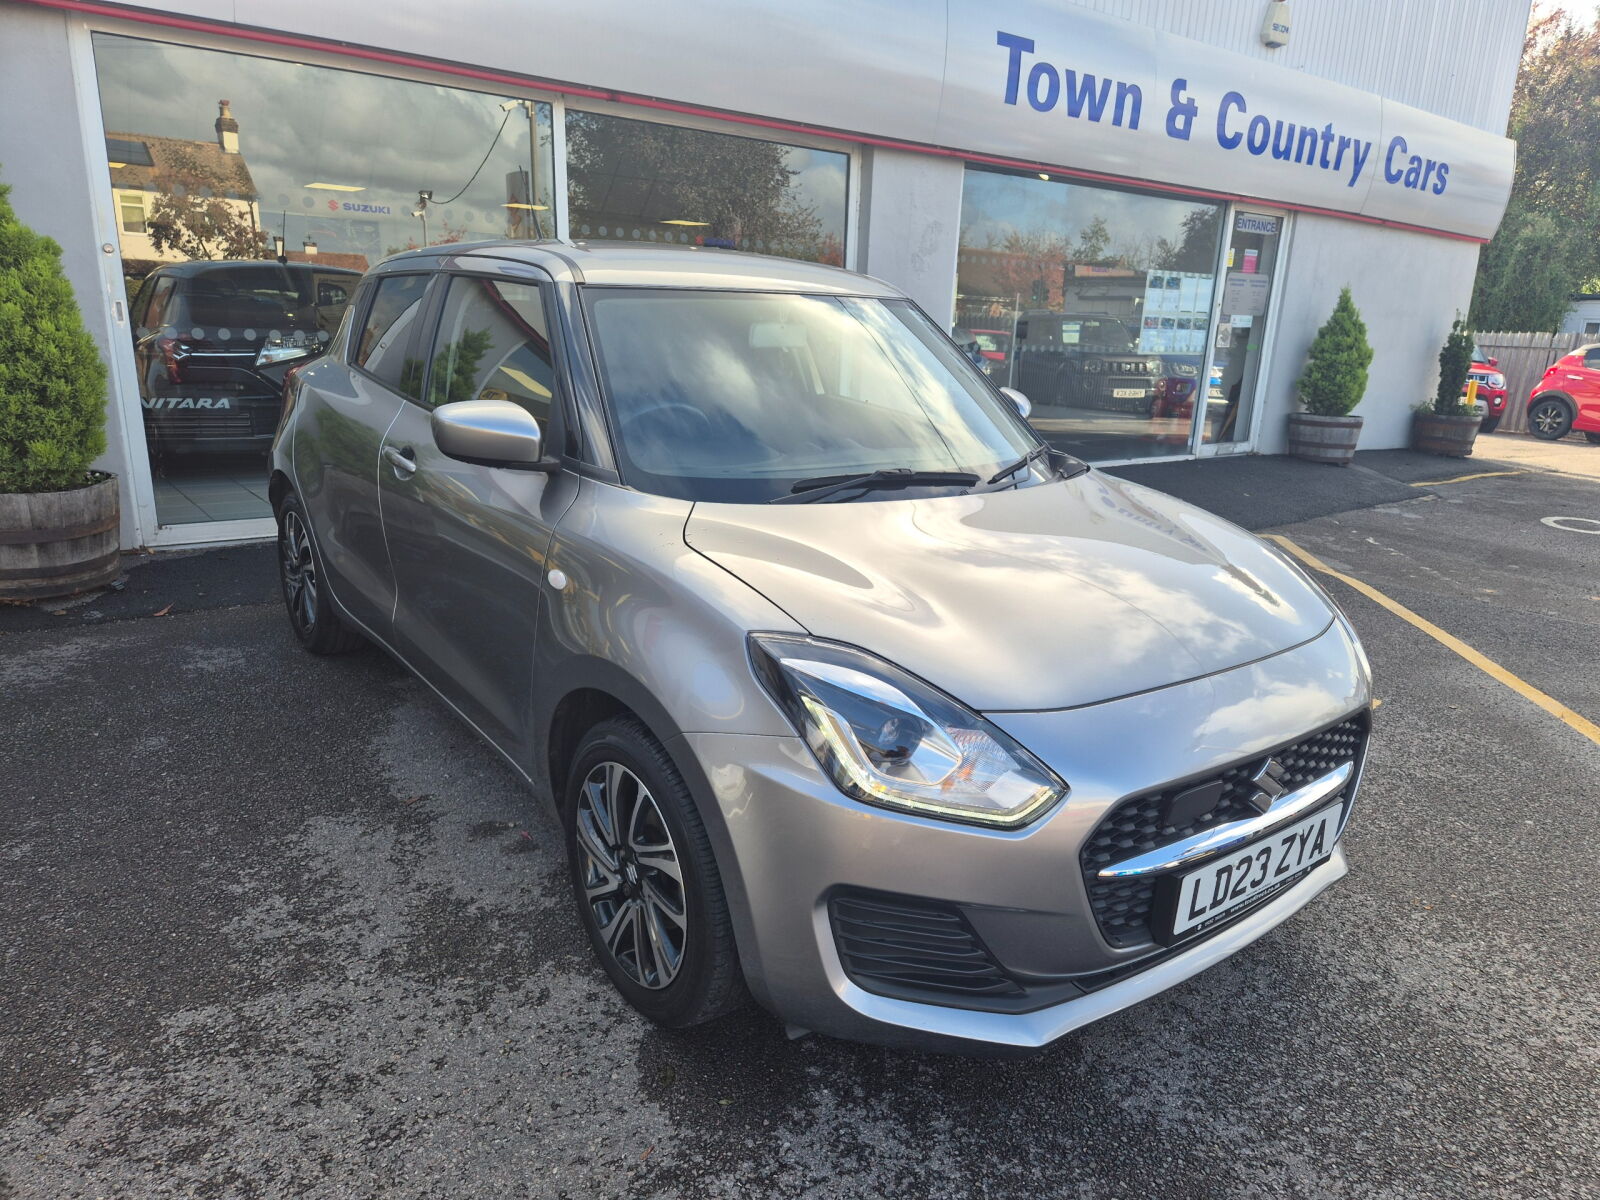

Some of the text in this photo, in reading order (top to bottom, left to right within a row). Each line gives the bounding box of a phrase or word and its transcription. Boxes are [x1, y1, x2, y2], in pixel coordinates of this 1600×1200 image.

[997, 31, 1449, 195] Town & Country Cars
[342, 202, 391, 215] SUZUKI
[1237, 218, 1276, 233] ENTRANCE
[141, 397, 231, 409] VITARA
[1188, 819, 1327, 921] LD23 ZYA
